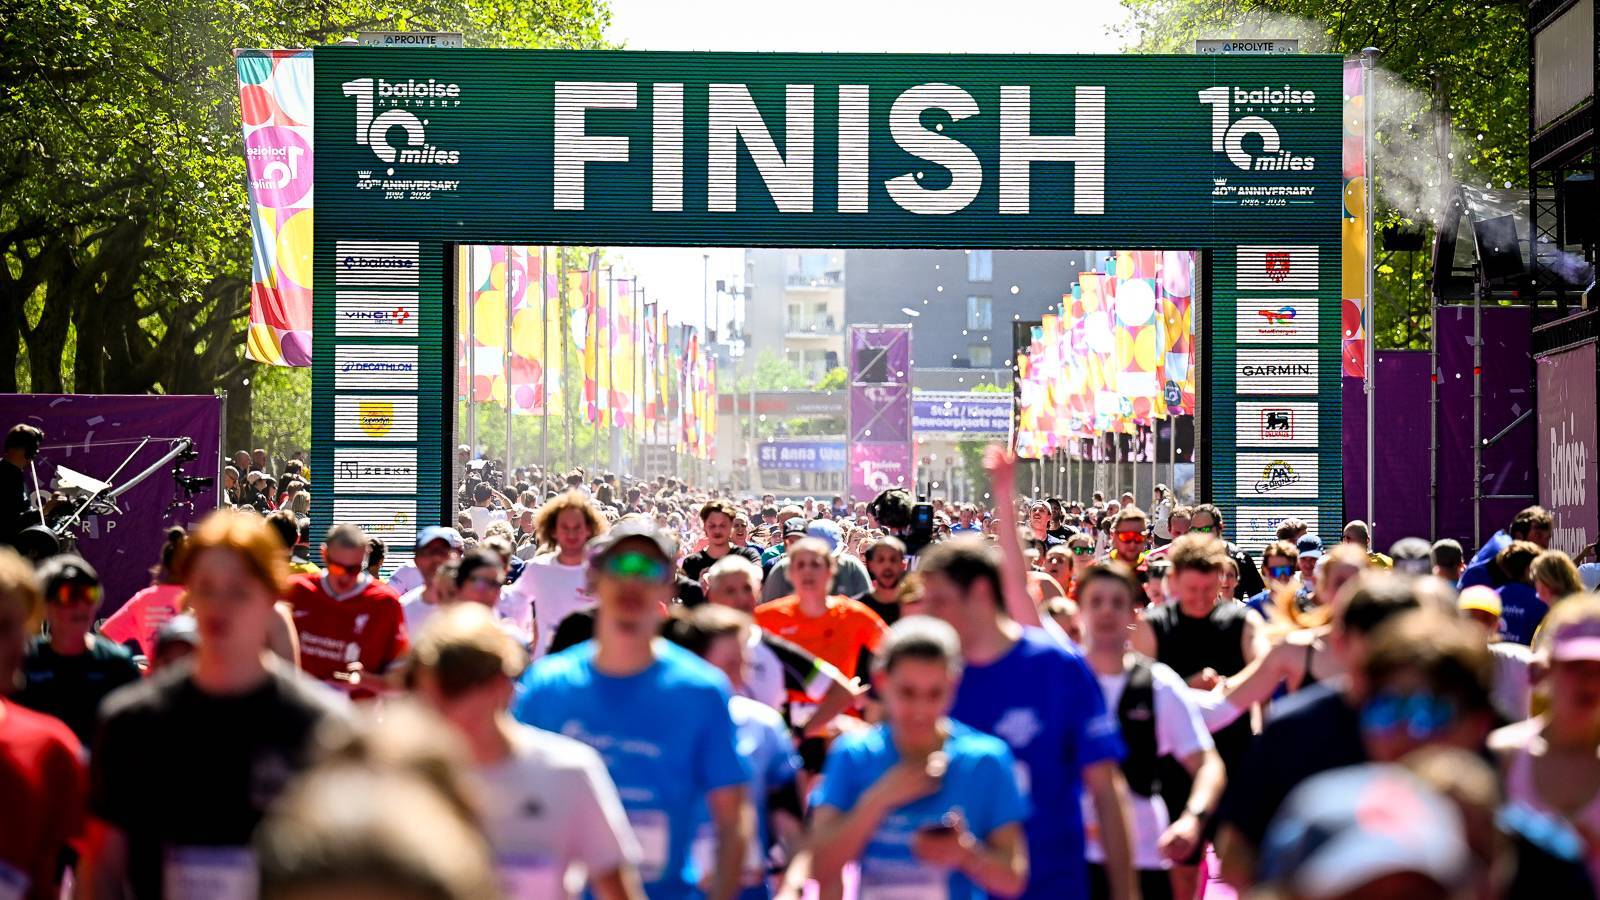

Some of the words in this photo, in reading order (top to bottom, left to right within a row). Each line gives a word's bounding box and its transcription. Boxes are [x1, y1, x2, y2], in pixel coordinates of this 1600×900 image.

[394, 35, 436, 45] PROLYTE
[1232, 42, 1274, 52] PROLYTE
[378, 78, 461, 98] baloise
[1234, 84, 1316, 104] baloise
[399, 143, 460, 164] miles
[554, 81, 1106, 215] FINISH
[1255, 149, 1316, 171] miles
[381, 180, 460, 191] ANNIVERSARY
[1212, 186, 1237, 196] 40TH
[1237, 186, 1315, 196] ANNIVERSARY
[345, 311, 388, 319] VINCI
[356, 363, 412, 372] DECATHLON
[781, 446, 816, 461] Anna
[1550, 412, 1587, 508] Baloise
[364, 467, 411, 475] ZEEKR
